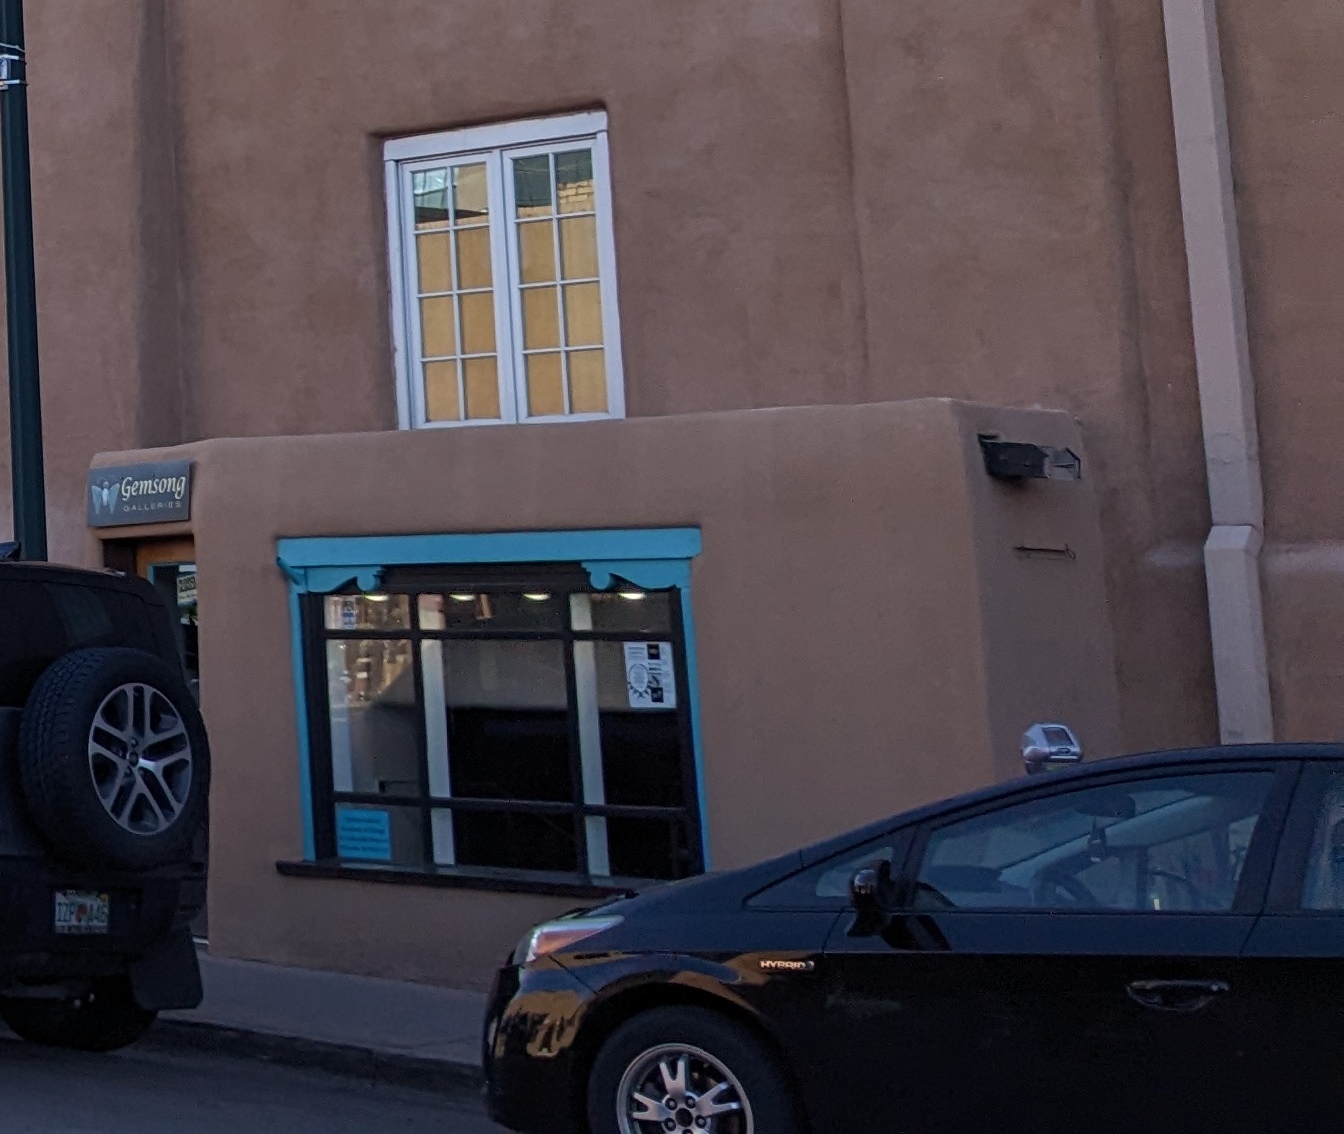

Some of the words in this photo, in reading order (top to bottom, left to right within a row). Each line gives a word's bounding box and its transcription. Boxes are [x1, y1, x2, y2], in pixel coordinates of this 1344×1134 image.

[121, 476, 187, 502] Gemsong
[123, 500, 182, 513] GALLERIES
[759, 960, 807, 969] HYBRID
